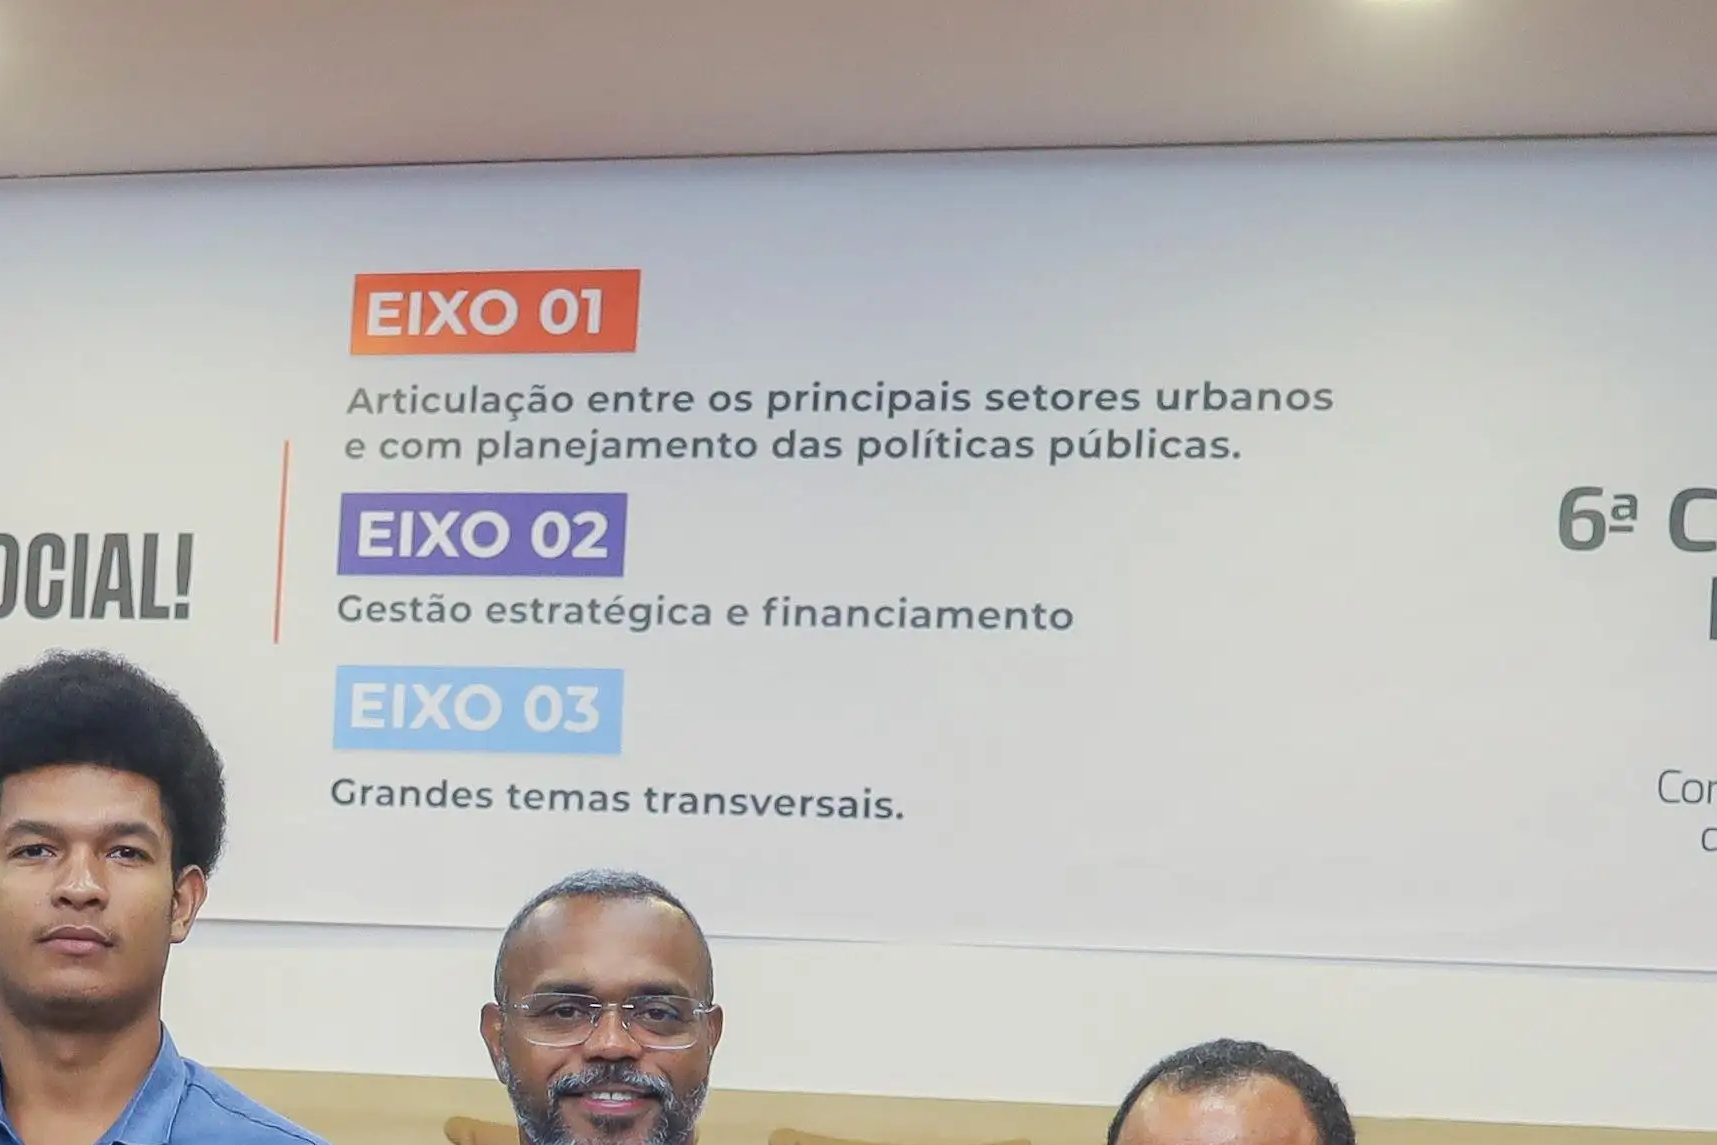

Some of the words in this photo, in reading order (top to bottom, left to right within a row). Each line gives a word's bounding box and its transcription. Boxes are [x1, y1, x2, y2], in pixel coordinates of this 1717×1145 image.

[365, 289, 519, 337] EIXO
[540, 289, 601, 334] 01
[348, 385, 573, 421] Articulação
[588, 387, 694, 412] entre
[709, 391, 752, 411] os
[768, 381, 970, 419] principais
[986, 385, 1140, 411] setores
[1157, 381, 1333, 410] urbanos
[345, 439, 365, 459] e
[380, 438, 461, 459] com
[477, 429, 757, 465] planejamento
[773, 430, 842, 458] das
[858, 428, 1033, 465] políticas
[1050, 428, 1240, 466] públicas.
[358, 511, 509, 557] EIXO
[532, 511, 607, 558] 02
[338, 594, 471, 622] Gestão
[486, 595, 711, 632] estratégica
[727, 605, 748, 625] e
[763, 596, 1073, 630] financiamento
[351, 683, 501, 730] EIXO
[524, 685, 599, 732] 03
[332, 779, 492, 808] Grandes
[507, 785, 629, 812] temas
[644, 788, 903, 819] transversais.
